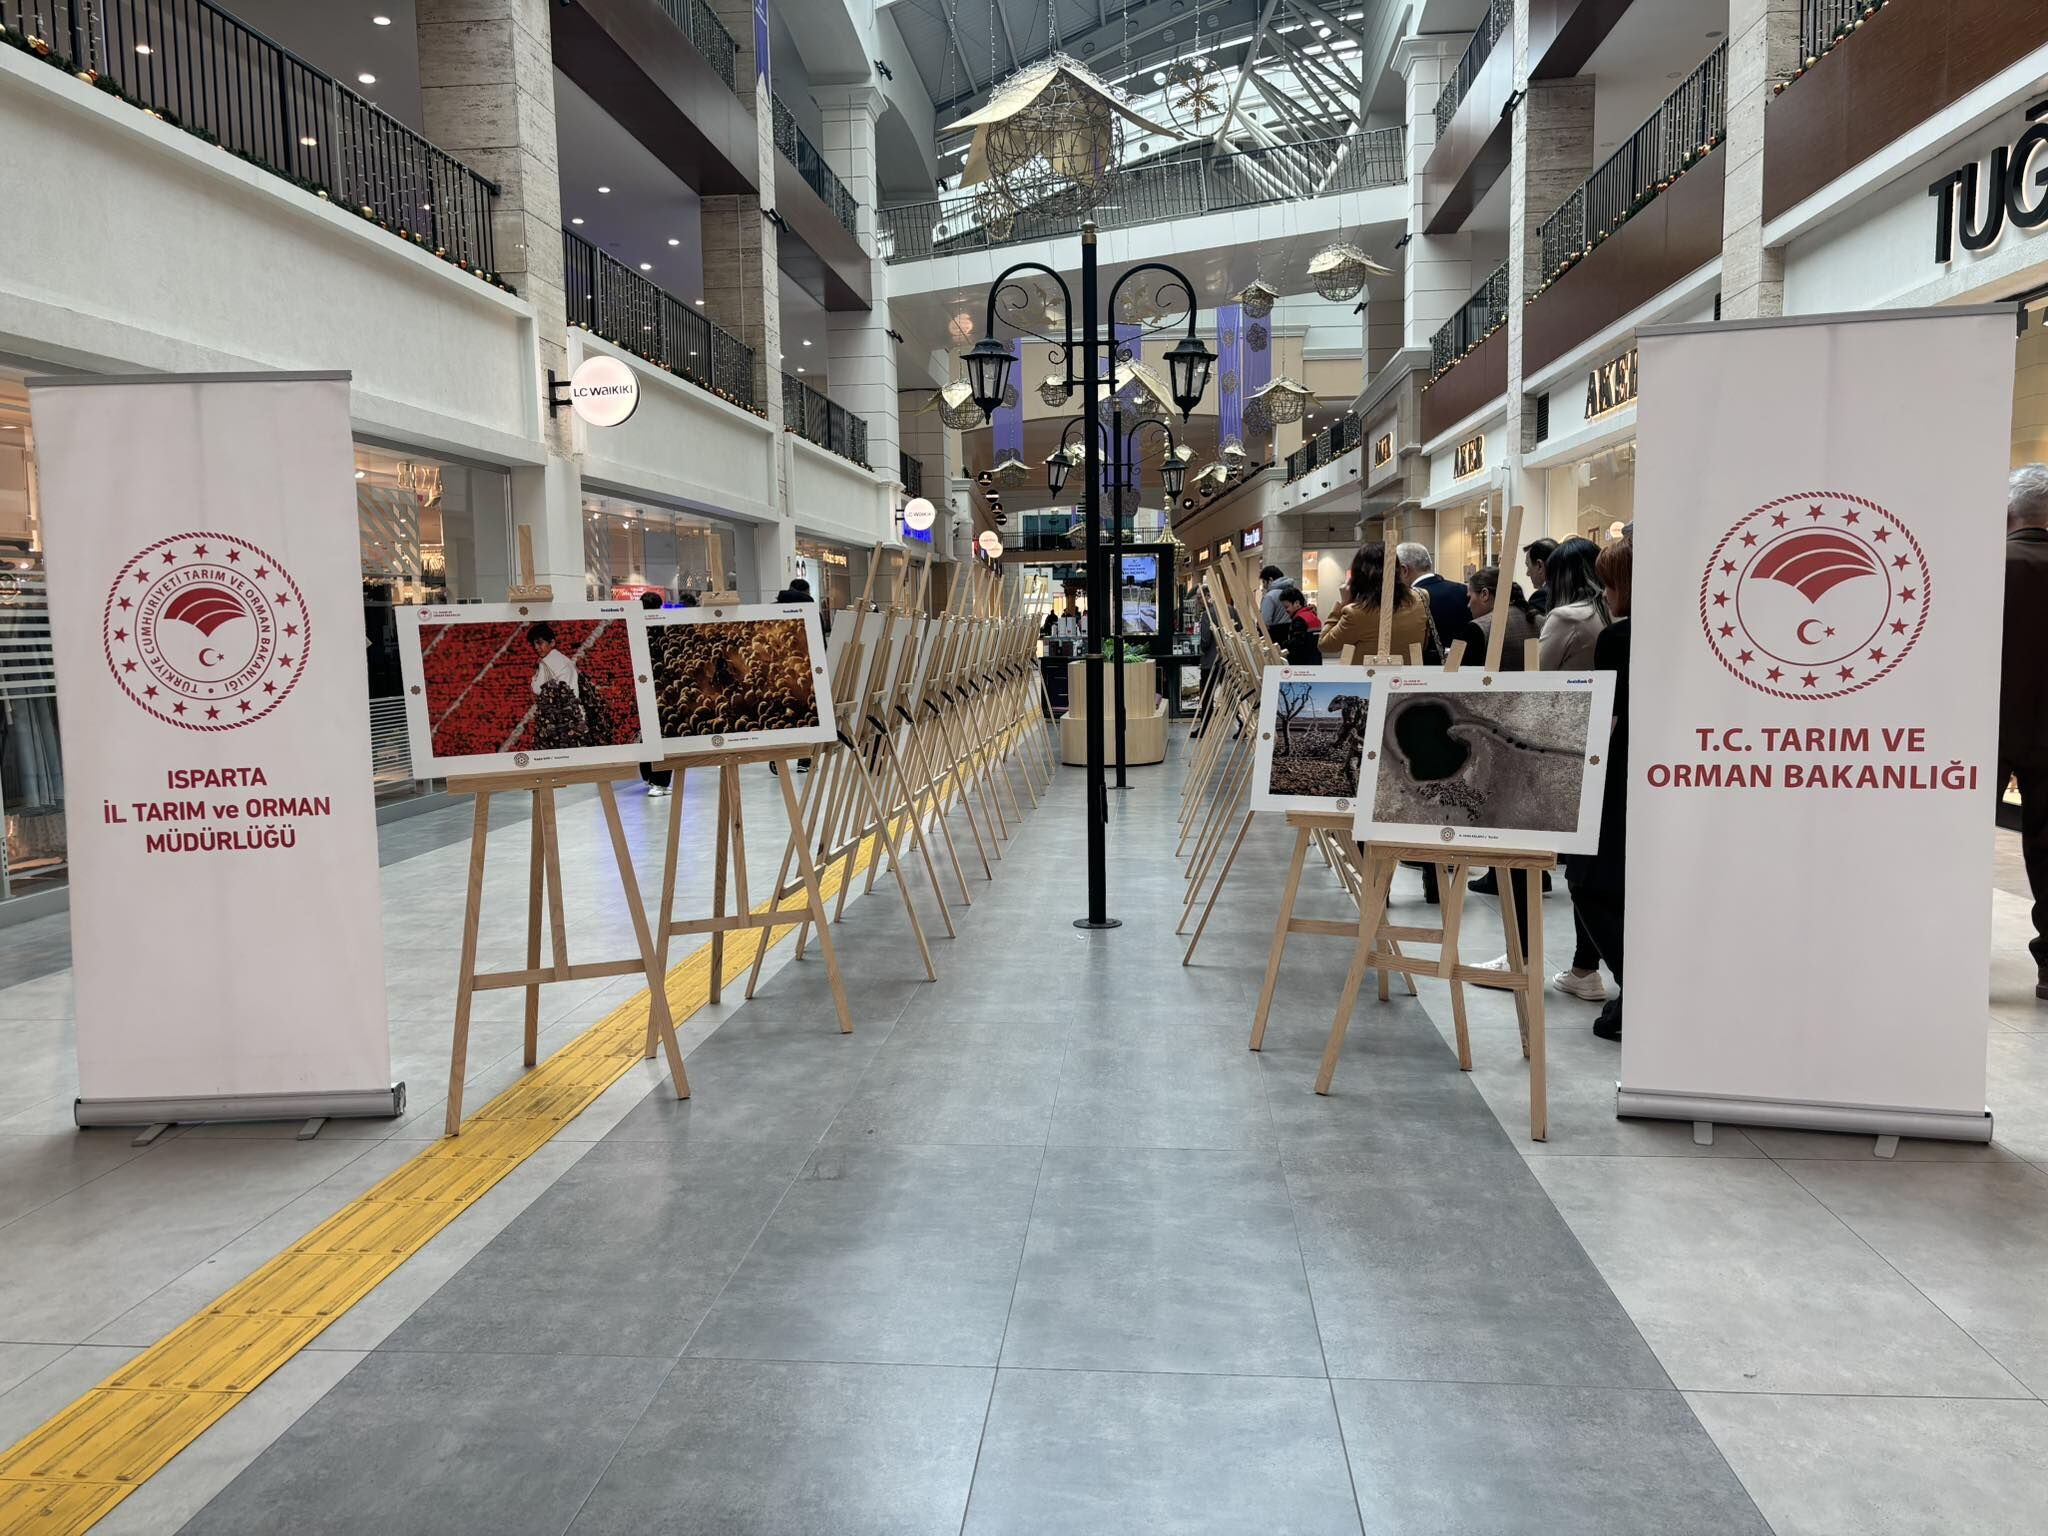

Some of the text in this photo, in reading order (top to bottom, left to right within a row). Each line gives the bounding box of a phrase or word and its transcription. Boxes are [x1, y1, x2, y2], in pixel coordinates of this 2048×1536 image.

[573, 387, 588, 397] LC
[141, 569, 271, 694] TÜRKİYE CUMHURİYETİ TARIM VE ORMAN BAKANLIĞI
[1695, 727, 1926, 752] T.C. TARIM VE
[168, 767, 267, 789] ISPARTA
[1647, 760, 1977, 790] ORMAN BAKANLIĞI
[103, 797, 331, 824] İL TARIM ve ORMAN
[146, 824, 296, 853] MÜDÜRLÜĞÜ
